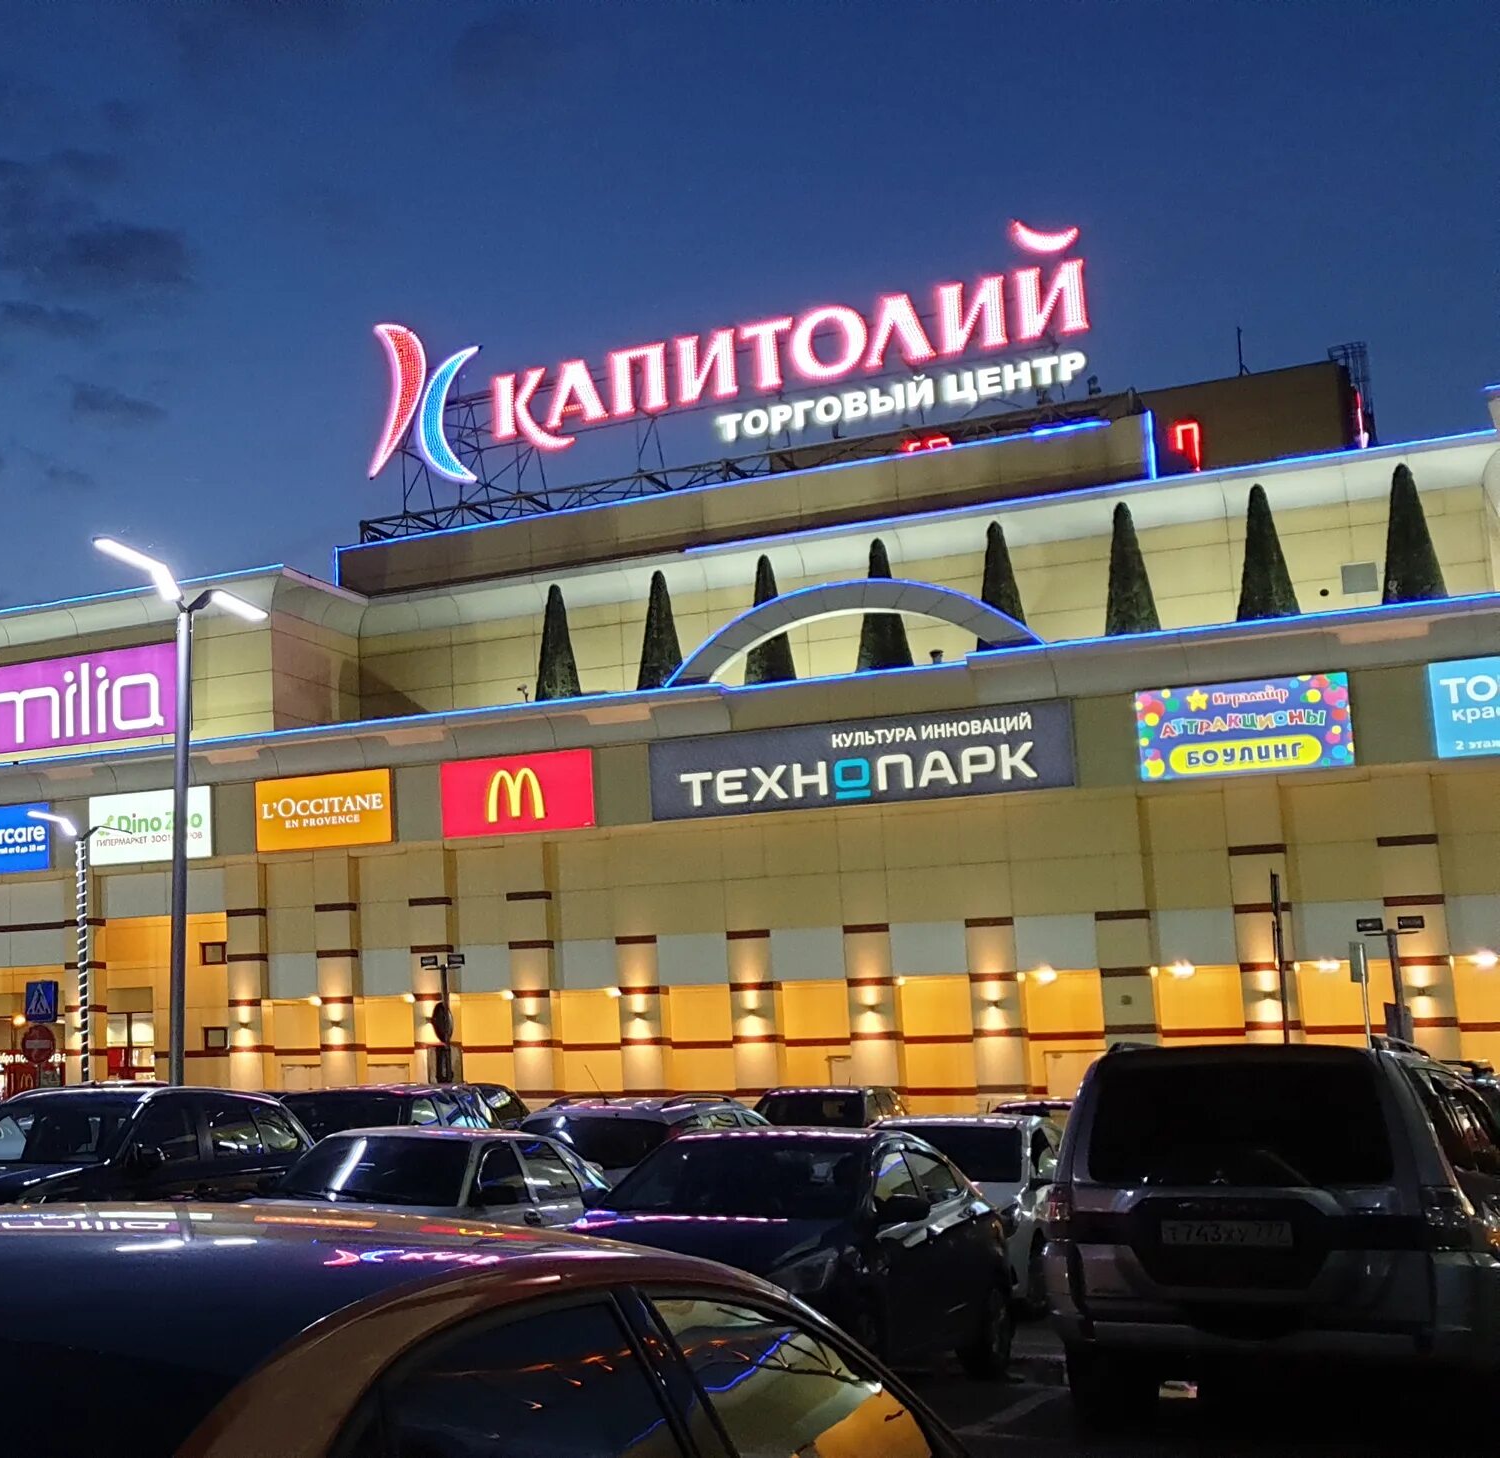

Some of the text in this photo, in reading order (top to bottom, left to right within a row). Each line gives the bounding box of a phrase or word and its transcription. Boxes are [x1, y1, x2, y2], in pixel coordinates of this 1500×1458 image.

[490, 219, 1090, 452] КАПИТОЛИЙ
[717, 351, 1088, 442] ТОРГОВЫЙ ЦЕНТР
[1439, 674, 1500, 704] ТО
[831, 711, 1033, 749] КУЛЬТУРА ИННОВАЦИЙ
[1160, 709, 1327, 739] АТТРАКЦИОНЫ
[1186, 741, 1304, 767] БОУЛИНГ
[1455, 740, 1465, 751] 2
[680, 741, 1038, 807] ТЕХНОПАРК
[261, 793, 384, 820] L'OCCITANE
[117, 810, 203, 833] Dino Zo
[285, 814, 360, 829] EN PROVENCE
[96, 835, 148, 847] ГИПЕРМАРКЕТ
